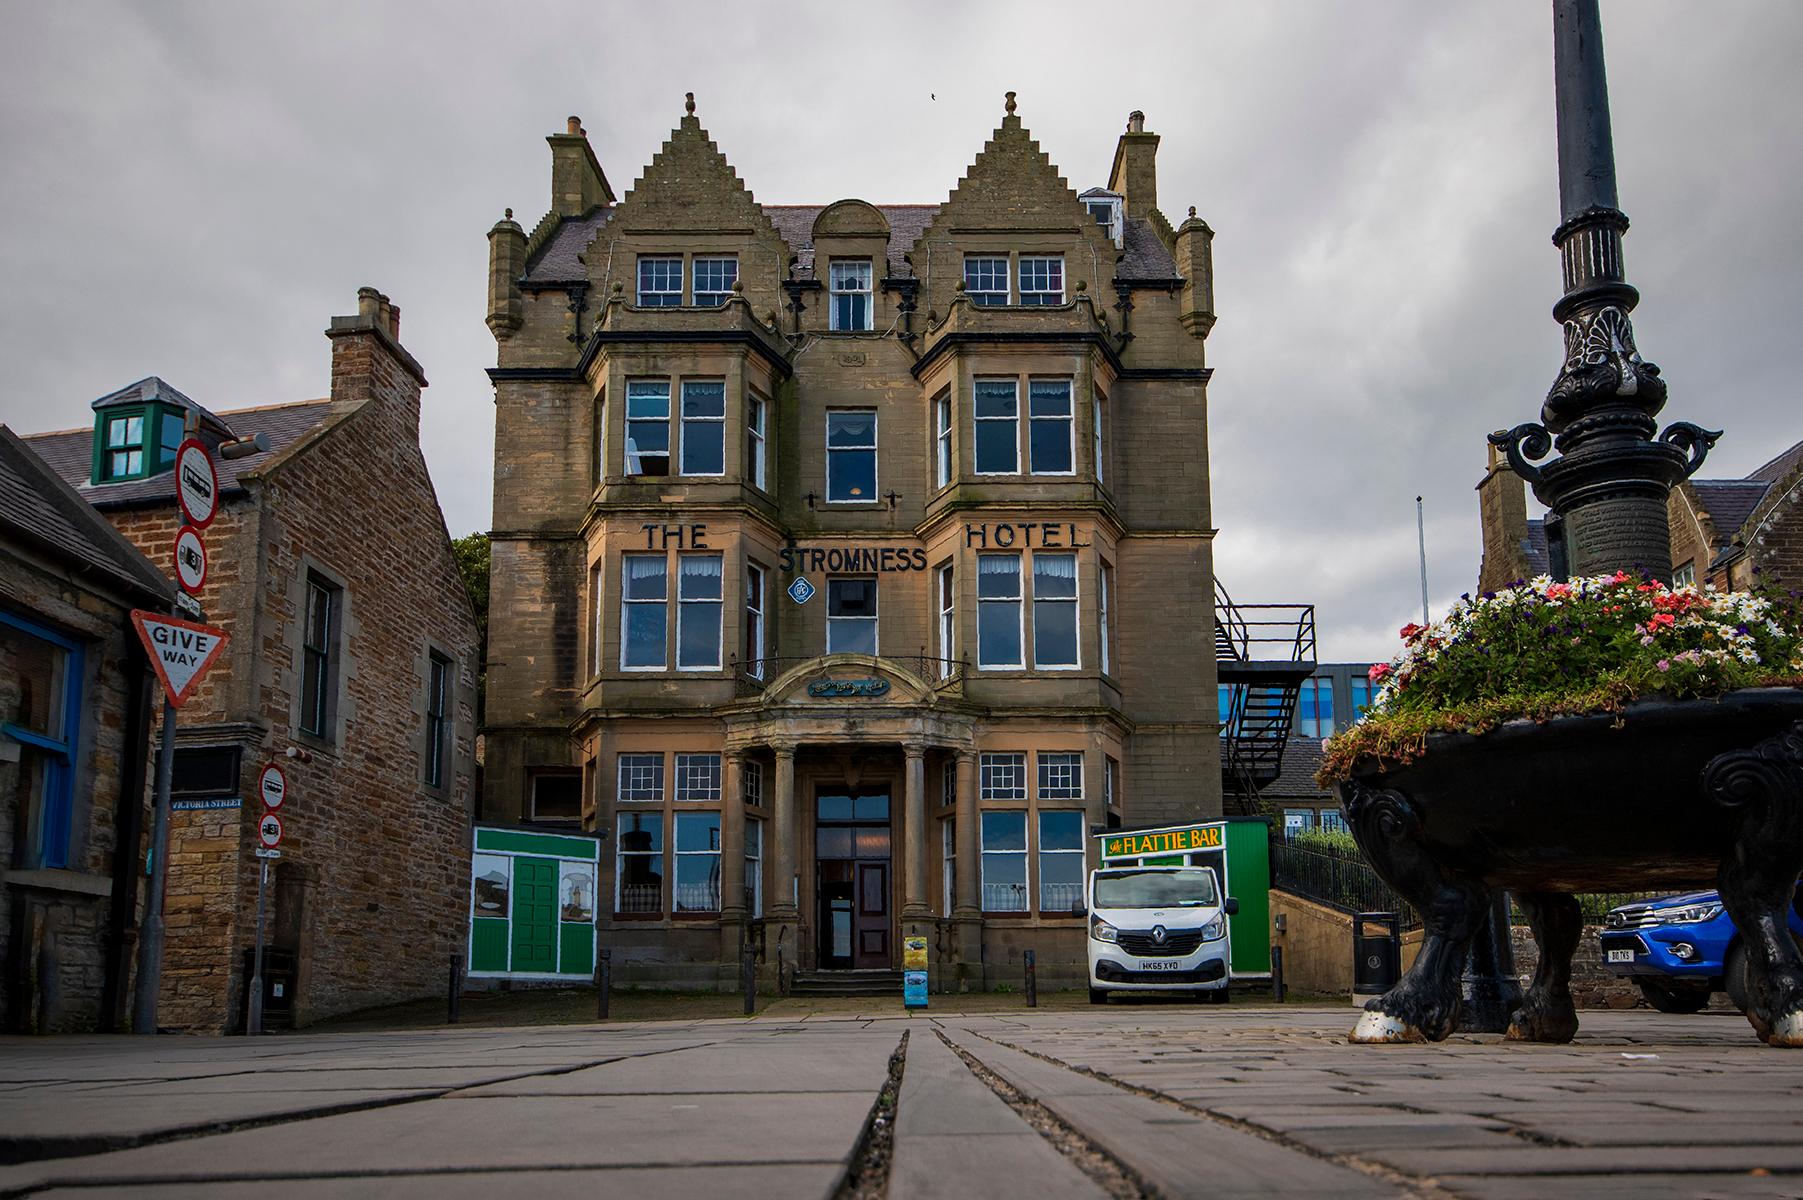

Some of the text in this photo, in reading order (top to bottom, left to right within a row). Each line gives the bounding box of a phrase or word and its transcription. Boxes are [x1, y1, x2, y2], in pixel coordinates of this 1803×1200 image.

[642, 522, 1091, 572] THE STROMNESS HOTEL
[153, 626, 208, 653] GIVE
[163, 649, 198, 667] WAY
[172, 799, 241, 809] VICTORIA STREET
[1123, 831, 1187, 854] FLATTIE
[1190, 828, 1220, 848] BAR
